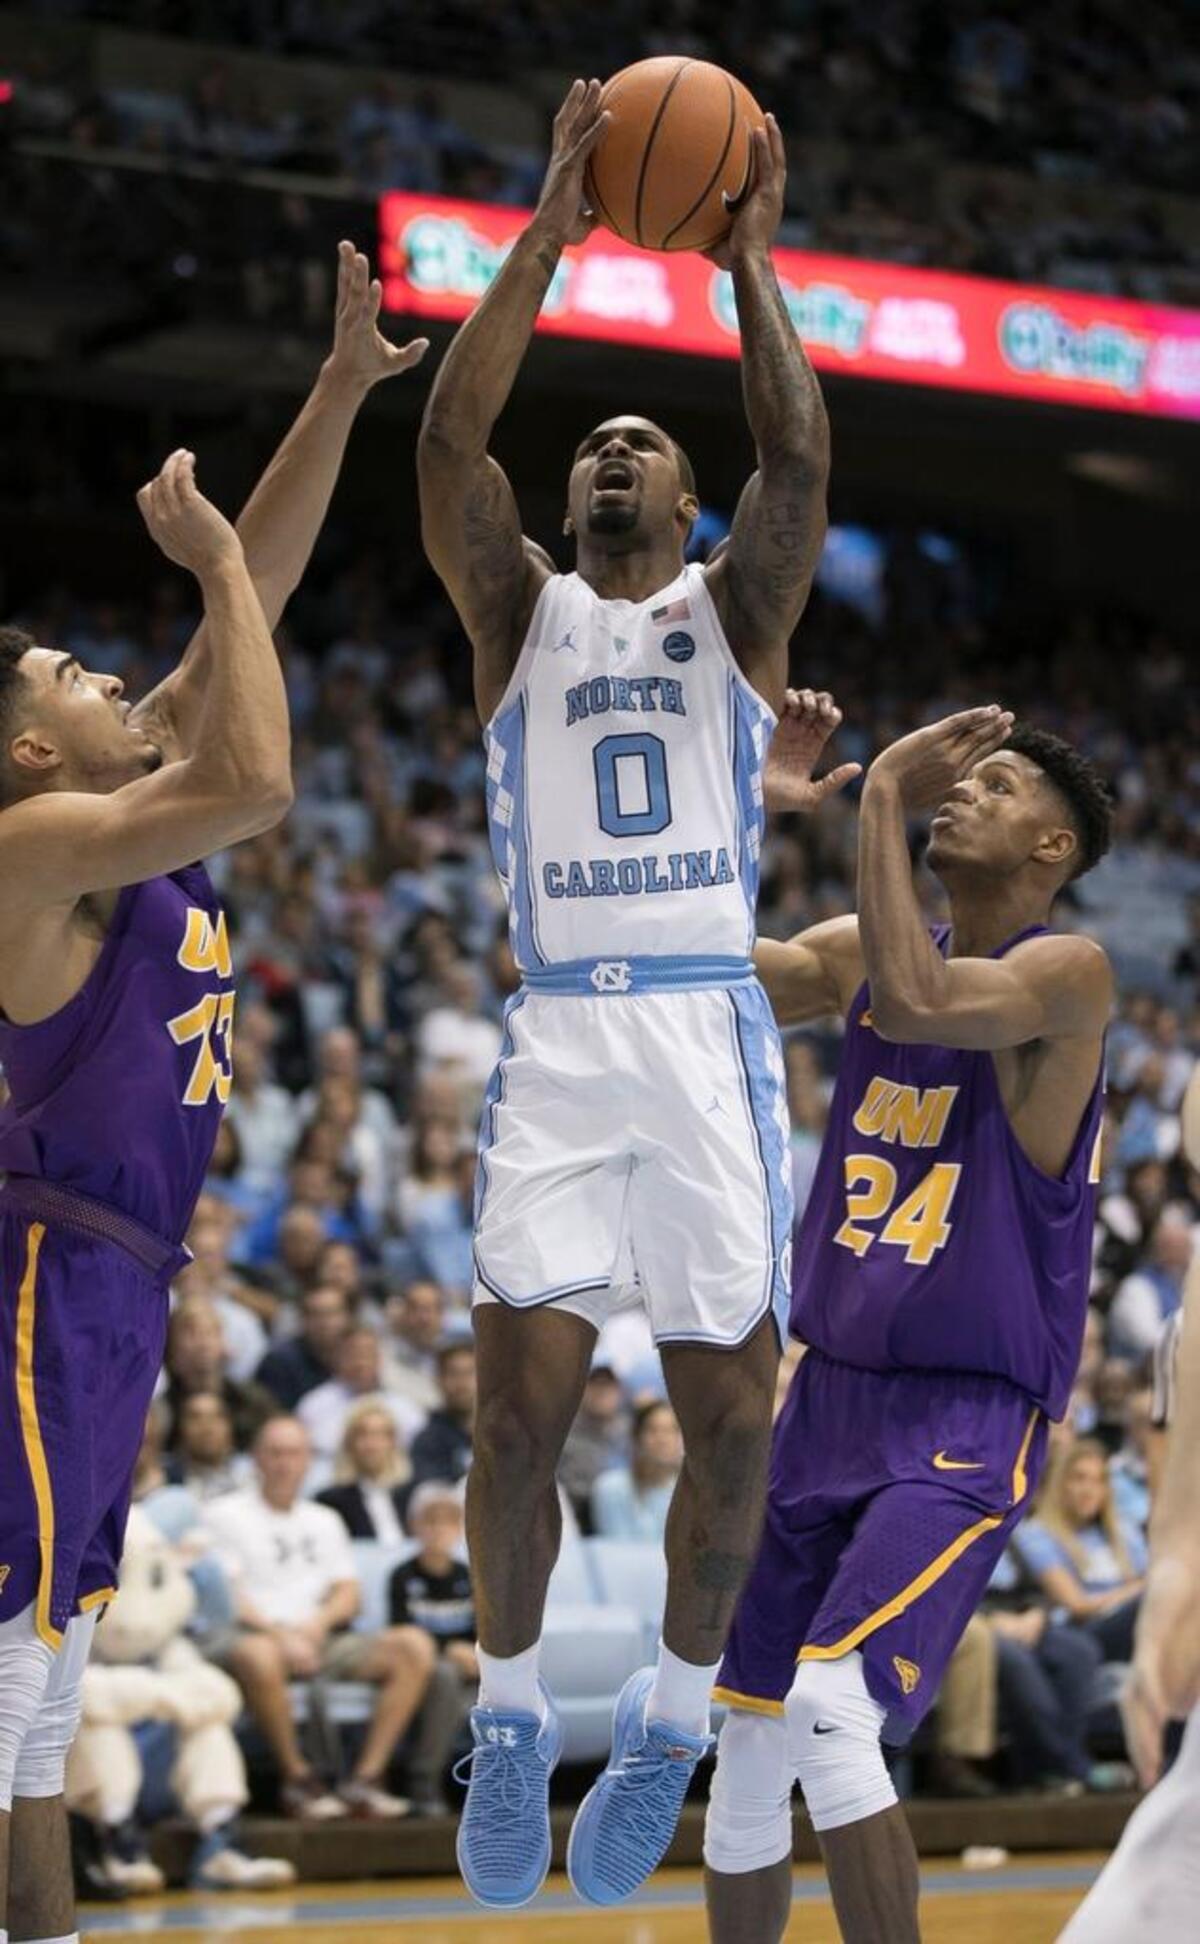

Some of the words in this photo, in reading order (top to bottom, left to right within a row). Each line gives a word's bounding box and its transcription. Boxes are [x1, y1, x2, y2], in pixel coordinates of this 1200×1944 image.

[565, 675, 687, 727] NORTH
[593, 732, 672, 838] 0
[543, 847, 736, 899] CAROLINA
[852, 1075, 960, 1148] UNI
[833, 1154, 963, 1266] 24
